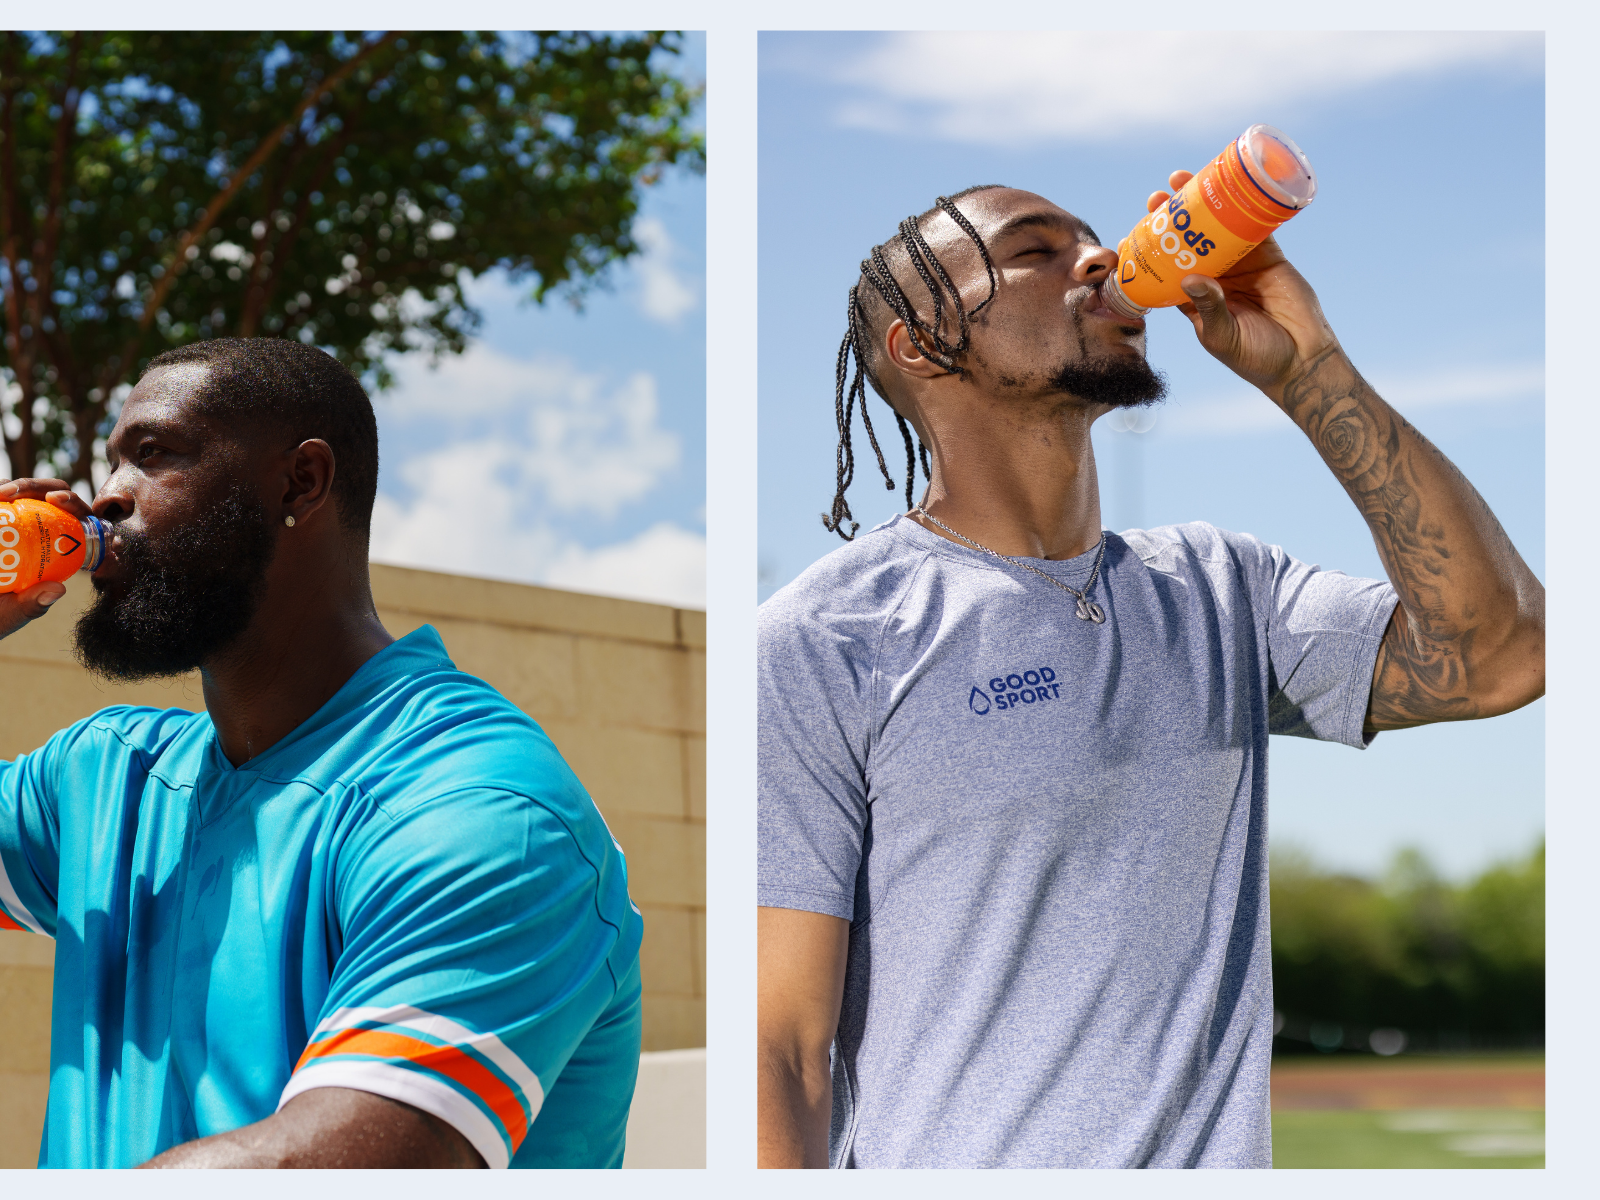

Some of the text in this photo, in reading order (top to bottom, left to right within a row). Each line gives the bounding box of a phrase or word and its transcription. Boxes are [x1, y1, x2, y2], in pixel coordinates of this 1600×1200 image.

[1203, 178, 1222, 210] CITRUS
[35, 513, 44, 544] POWERFUL
[989, 667, 1055, 692] GOOD
[995, 684, 1060, 710] SPORT
